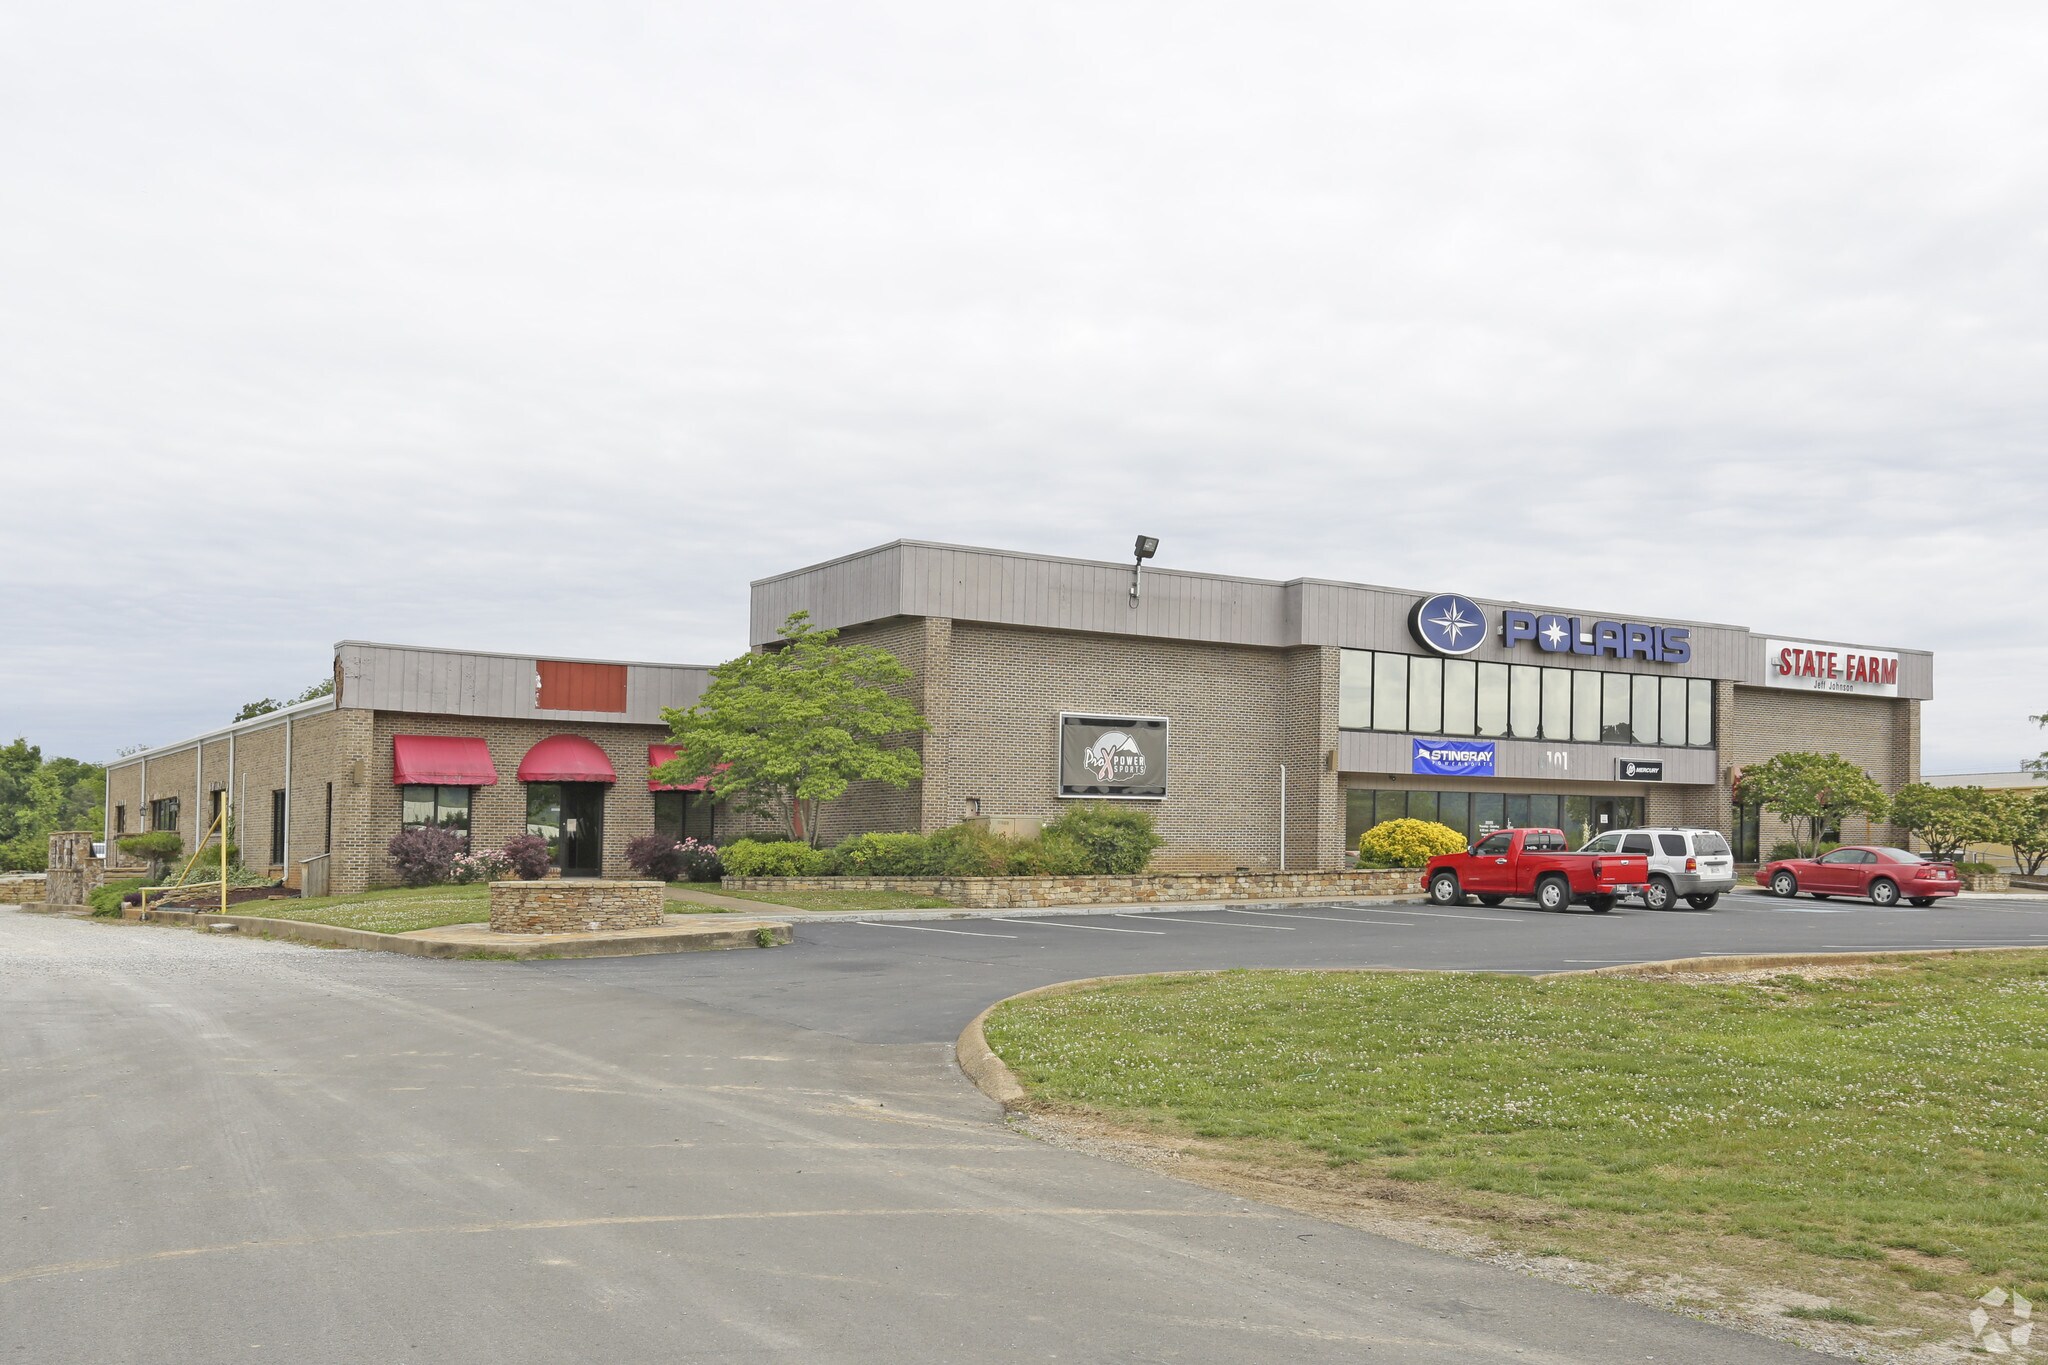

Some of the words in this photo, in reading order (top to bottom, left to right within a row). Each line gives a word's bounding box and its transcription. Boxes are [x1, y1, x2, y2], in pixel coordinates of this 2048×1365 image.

[1503, 610, 1691, 663] POLARIS
[1780, 647, 1838, 679] STATE
[1846, 654, 1898, 684] FARM
[1814, 680, 1826, 690] Jeff
[1829, 681, 1854, 692] Johnson
[1113, 755, 1144, 766] POWER
[1431, 750, 1493, 762] STINGRAY
[1113, 765, 1144, 773] SPORTS
[1635, 766, 1660, 774] MERCURY
